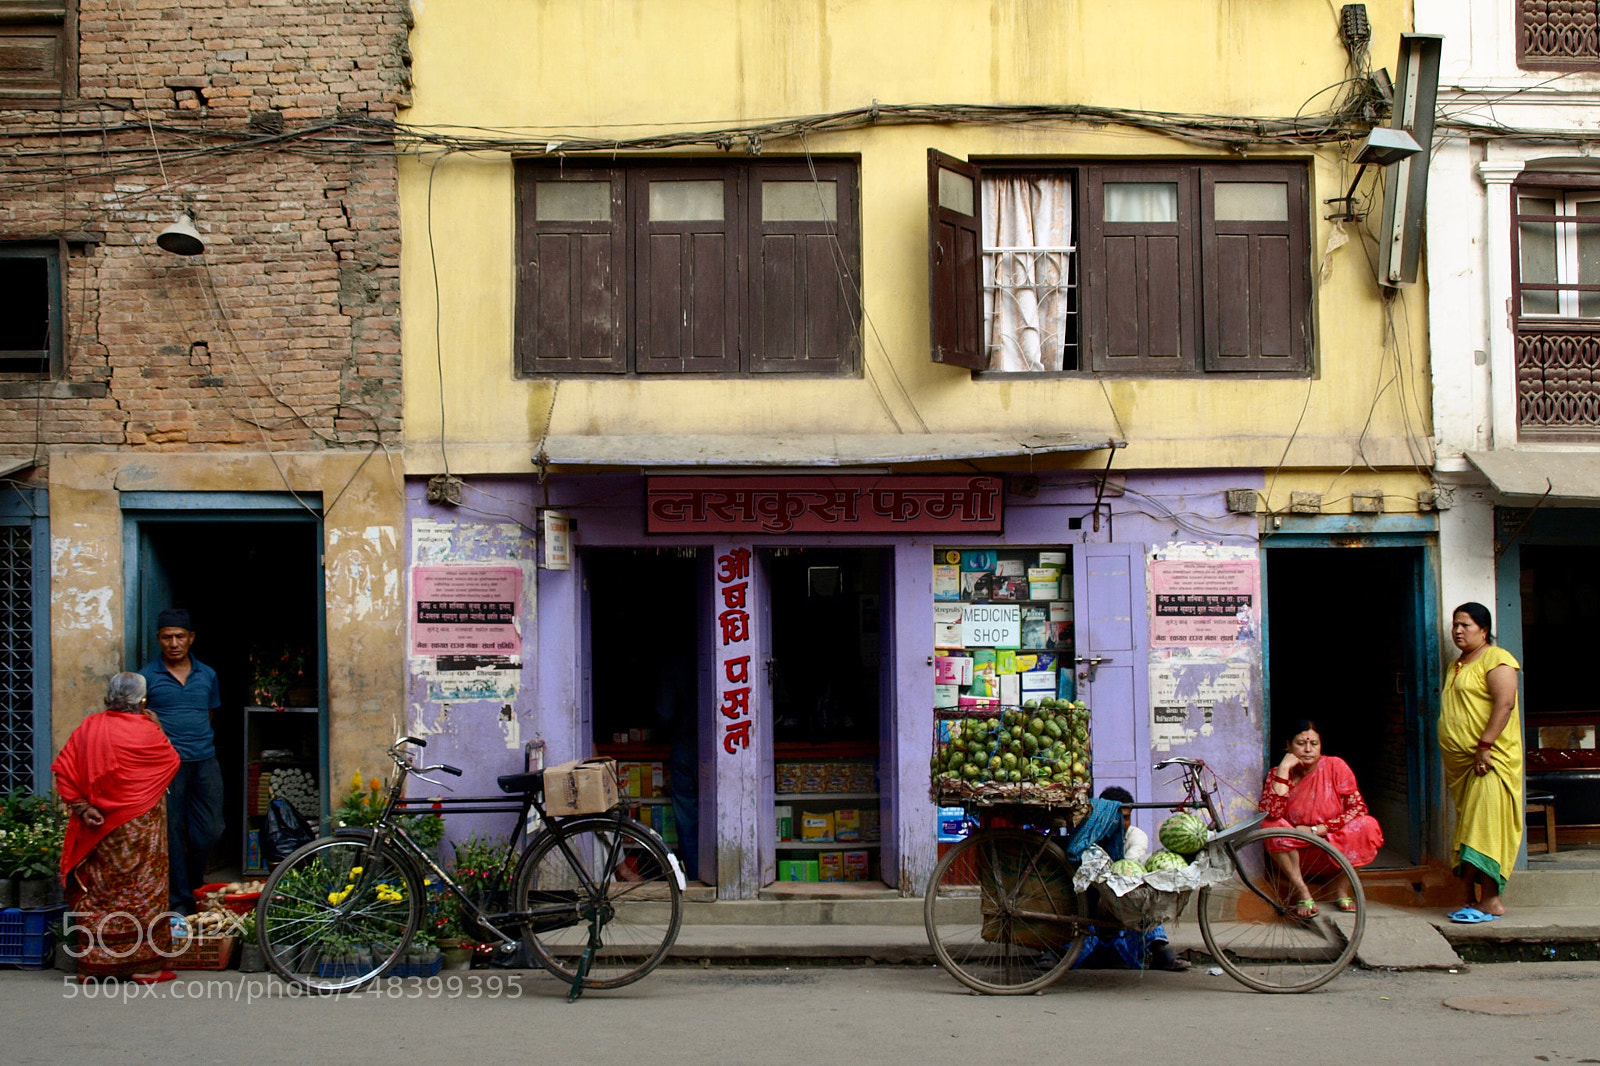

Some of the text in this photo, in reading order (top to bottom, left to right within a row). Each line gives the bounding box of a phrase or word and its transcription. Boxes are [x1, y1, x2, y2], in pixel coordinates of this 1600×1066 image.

[648, 488, 861, 534] लसकुस
[964, 608, 1019, 622] MEDICINE
[973, 628, 1009, 643] SHOP
[721, 655, 751, 754] पसल
